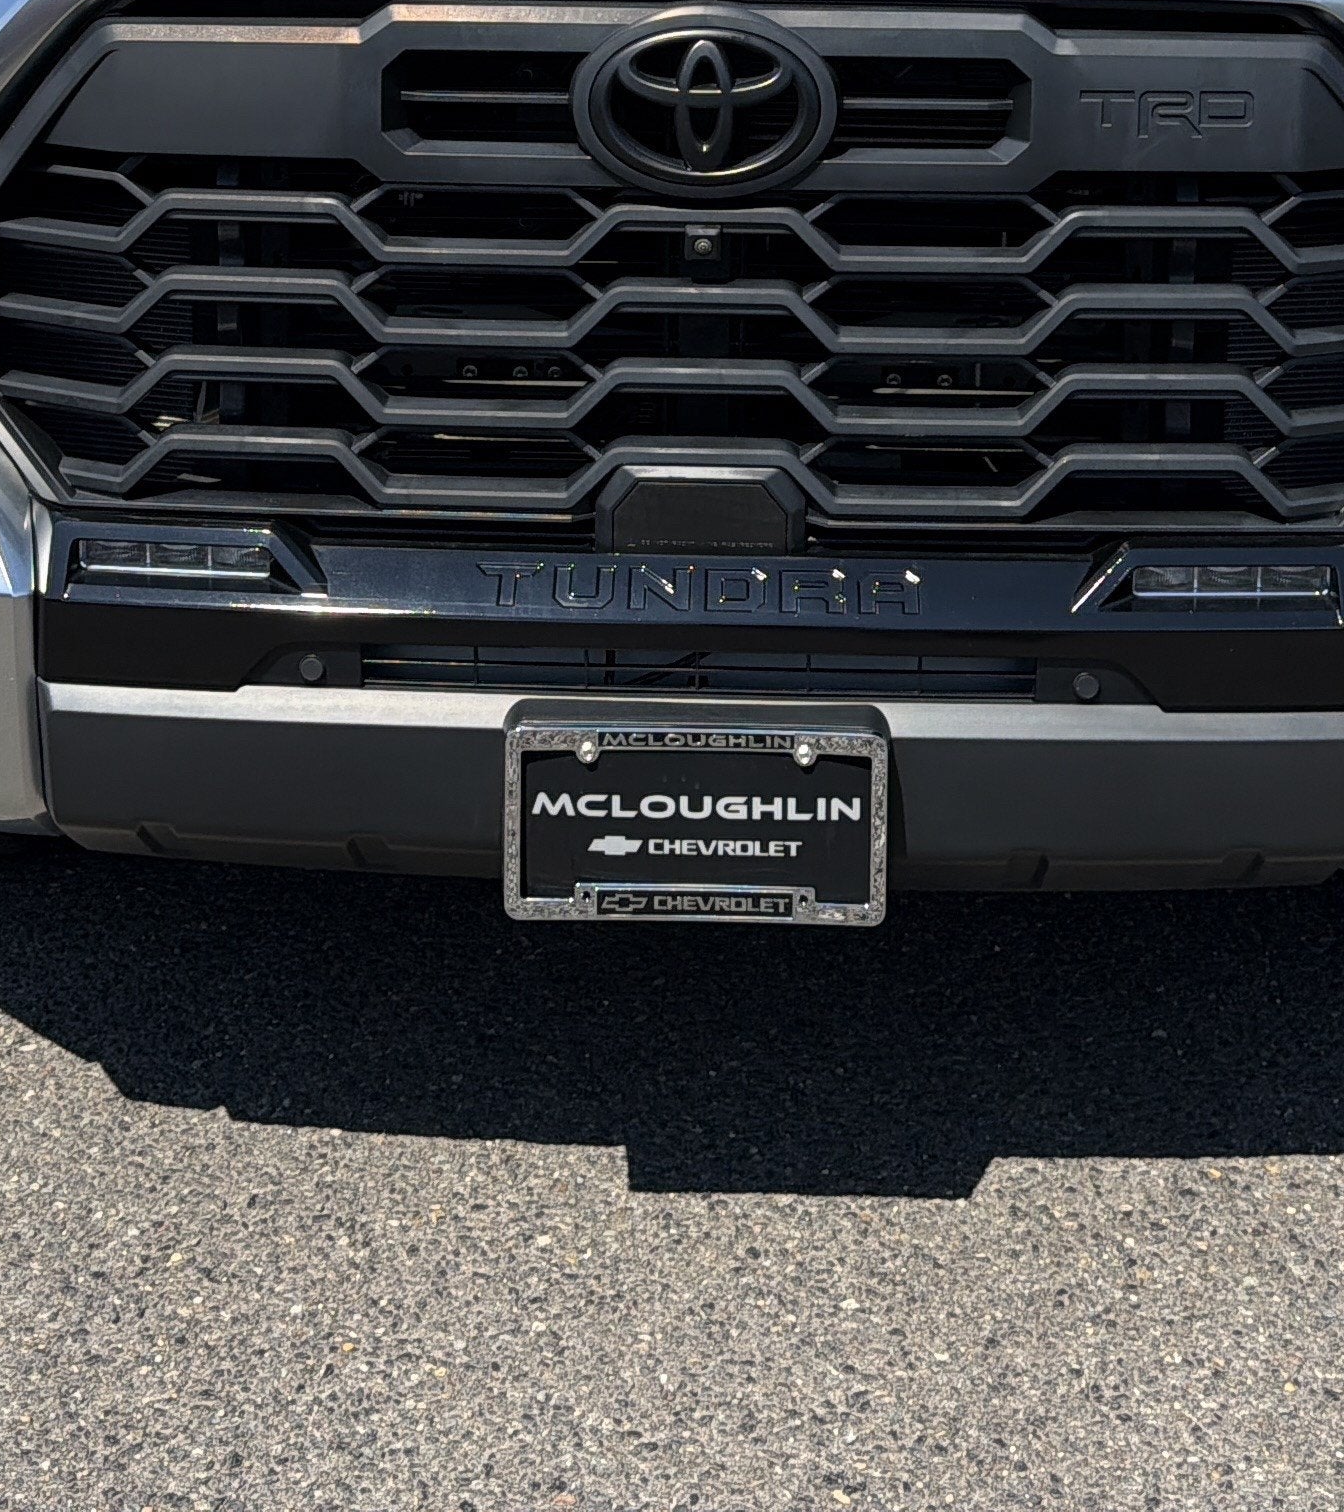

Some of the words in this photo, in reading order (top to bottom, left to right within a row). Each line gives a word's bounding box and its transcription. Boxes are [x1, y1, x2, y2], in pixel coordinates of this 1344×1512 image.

[1079, 90, 1255, 138] TRD
[476, 561, 922, 614] TUNDRA
[602, 732, 792, 749] MCLOUGHLIN
[532, 792, 861, 821] MCLOUGHLIN
[648, 838, 803, 857] CHEVROLET
[653, 895, 789, 913] CHEVROLET
